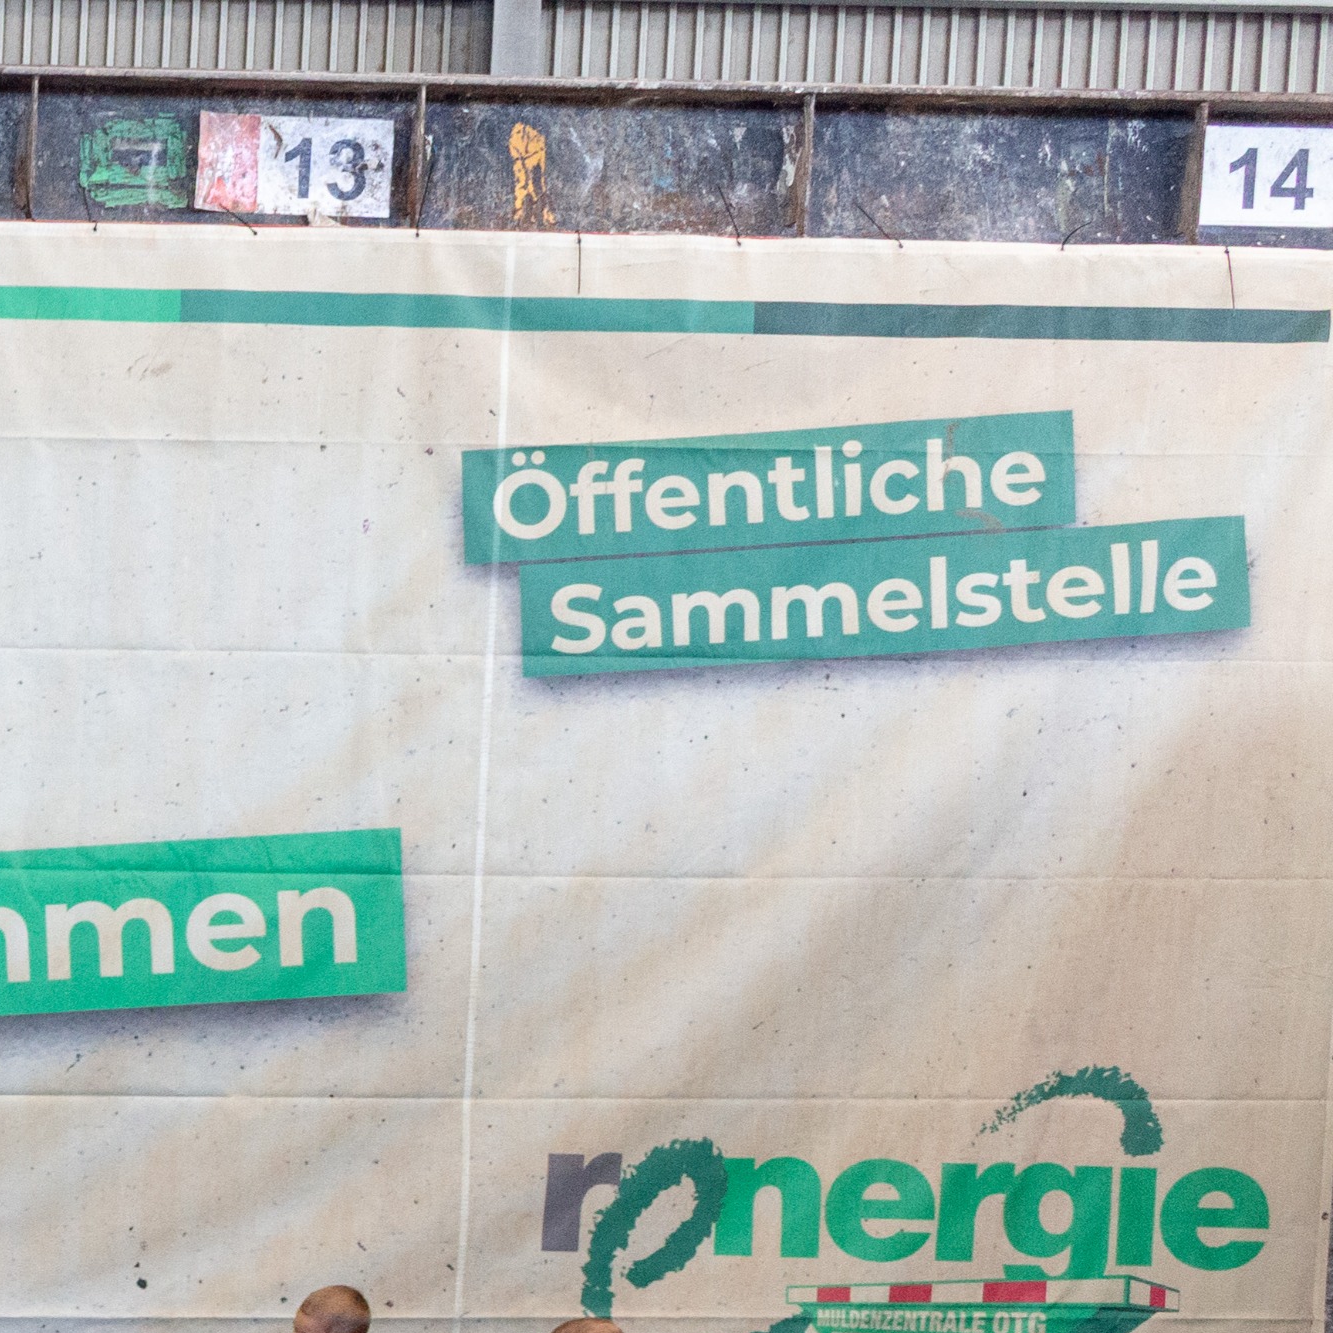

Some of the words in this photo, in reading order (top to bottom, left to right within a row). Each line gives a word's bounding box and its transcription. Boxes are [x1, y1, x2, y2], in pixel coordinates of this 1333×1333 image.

[284, 137, 367, 201] 13
[1229, 147, 1314, 210] 14
[492, 438, 1046, 540] Öffentliche
[549, 539, 1218, 655] Sammelstelle
